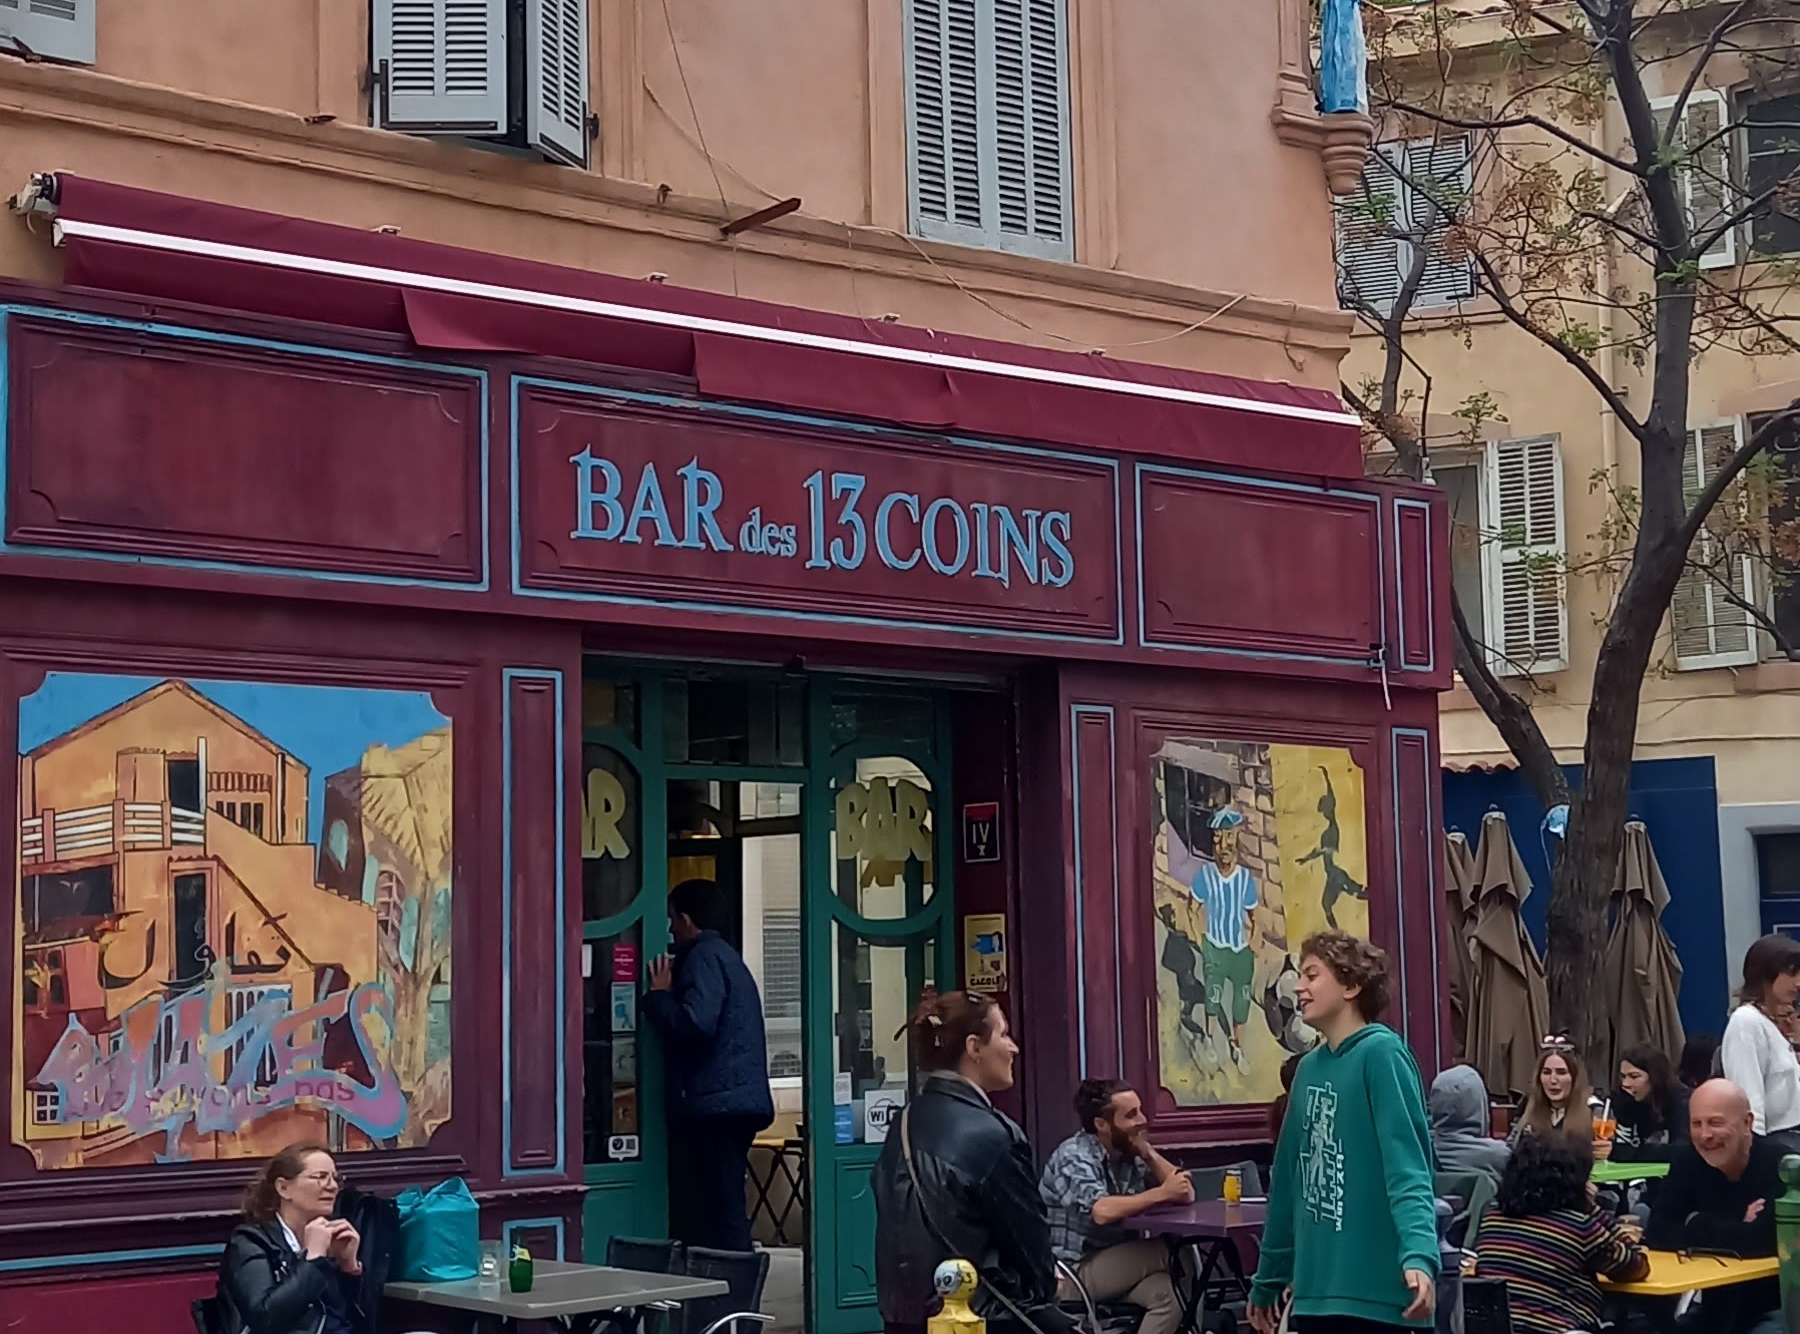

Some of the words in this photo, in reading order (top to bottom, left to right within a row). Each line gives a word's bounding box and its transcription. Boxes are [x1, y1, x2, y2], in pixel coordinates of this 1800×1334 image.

[568, 443, 734, 553] BAR
[739, 507, 797, 558] des
[802, 469, 866, 571] 13
[874, 490, 1075, 589] COINS
[835, 776, 933, 861] BAR
